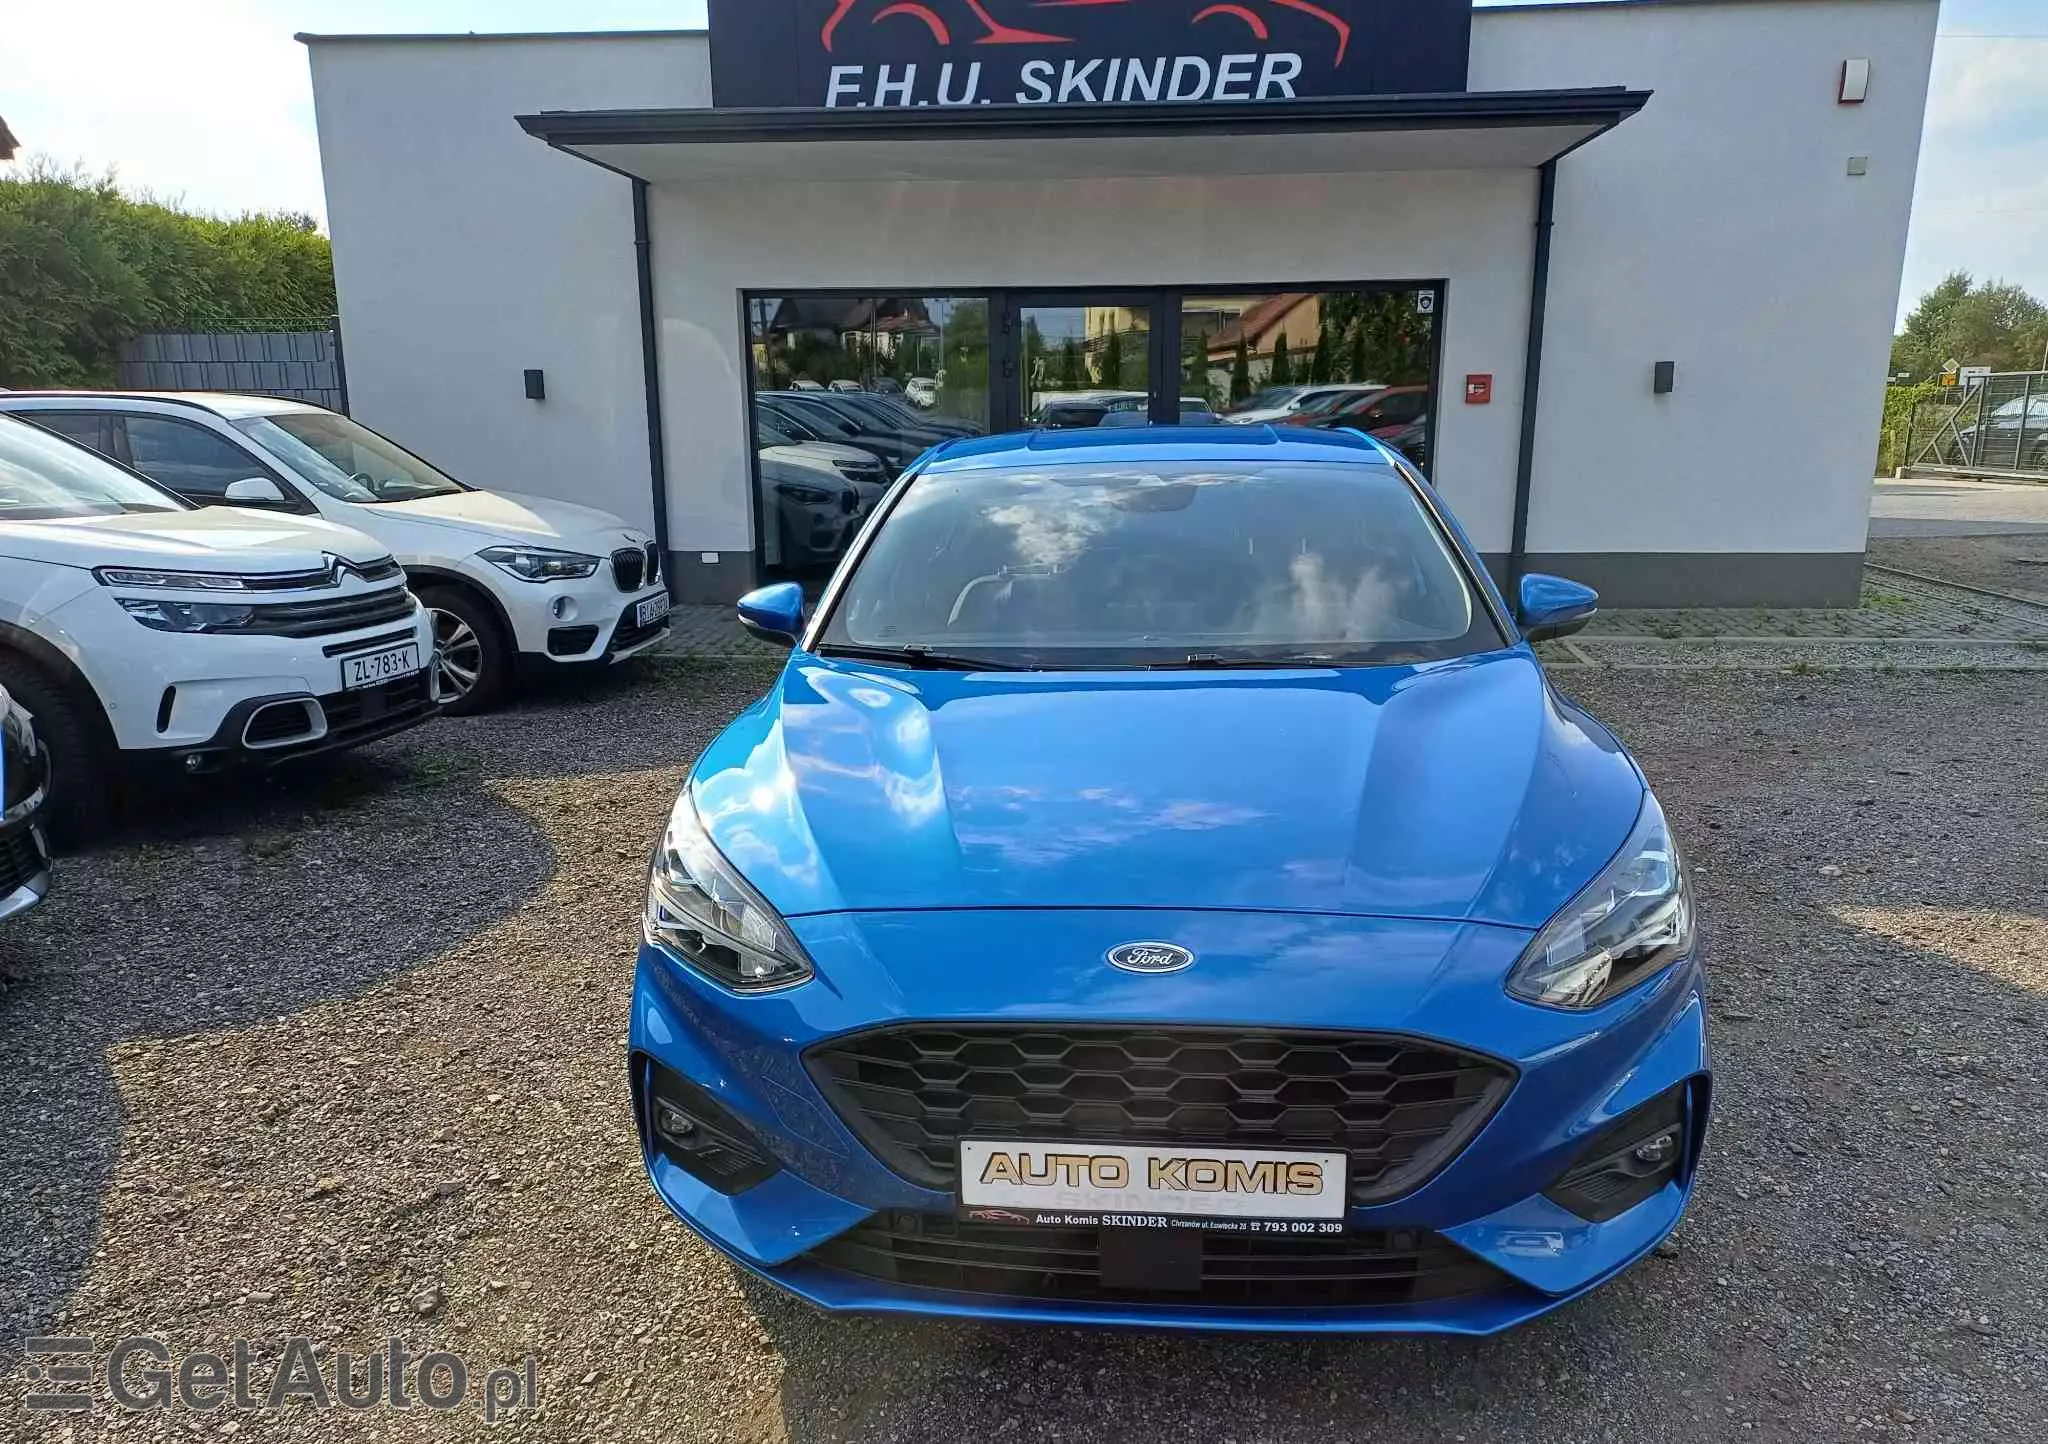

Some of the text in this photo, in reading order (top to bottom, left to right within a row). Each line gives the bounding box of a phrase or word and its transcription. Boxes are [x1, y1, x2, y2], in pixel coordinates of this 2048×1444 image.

[825, 52, 1303, 108] F.H.U. SKINDER
[1127, 947, 1174, 965] Ford
[979, 1151, 1324, 1196] AUTO KOMIS
[1036, 1213, 1062, 1225] Auto
[1064, 1214, 1099, 1226] Komis
[1102, 1214, 1168, 1228] SKINDER
[1264, 1221, 1288, 1233] 793
[1291, 1222, 1316, 1233] 002
[1318, 1222, 1343, 1233] 309
